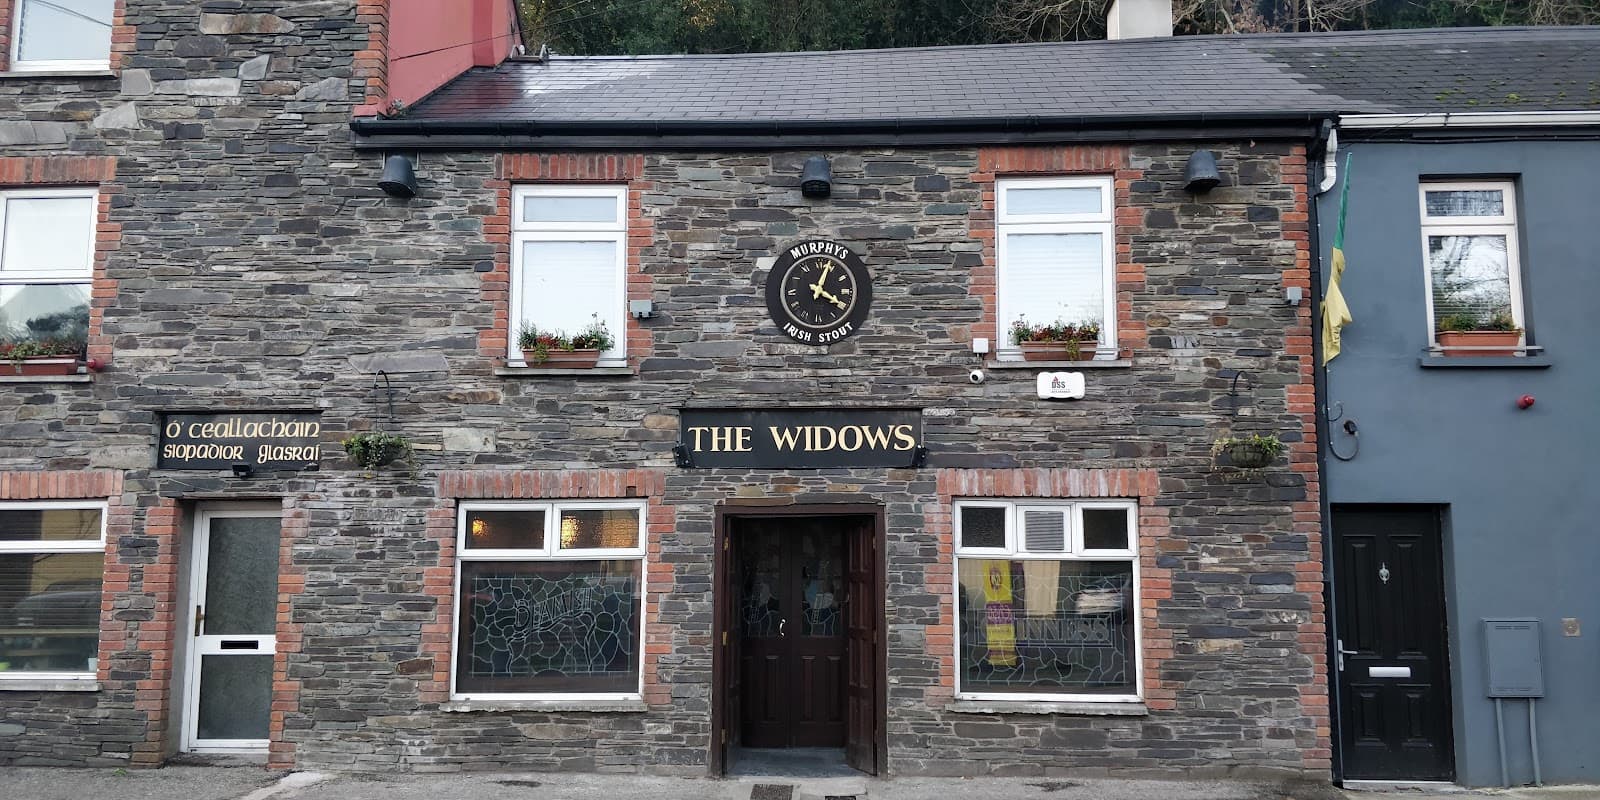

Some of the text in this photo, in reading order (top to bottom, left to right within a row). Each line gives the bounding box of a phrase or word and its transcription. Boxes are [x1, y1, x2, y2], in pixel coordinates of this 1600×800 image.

[783, 321, 854, 343] IRISH STOUT
[687, 424, 915, 452] THE WIDOWS
